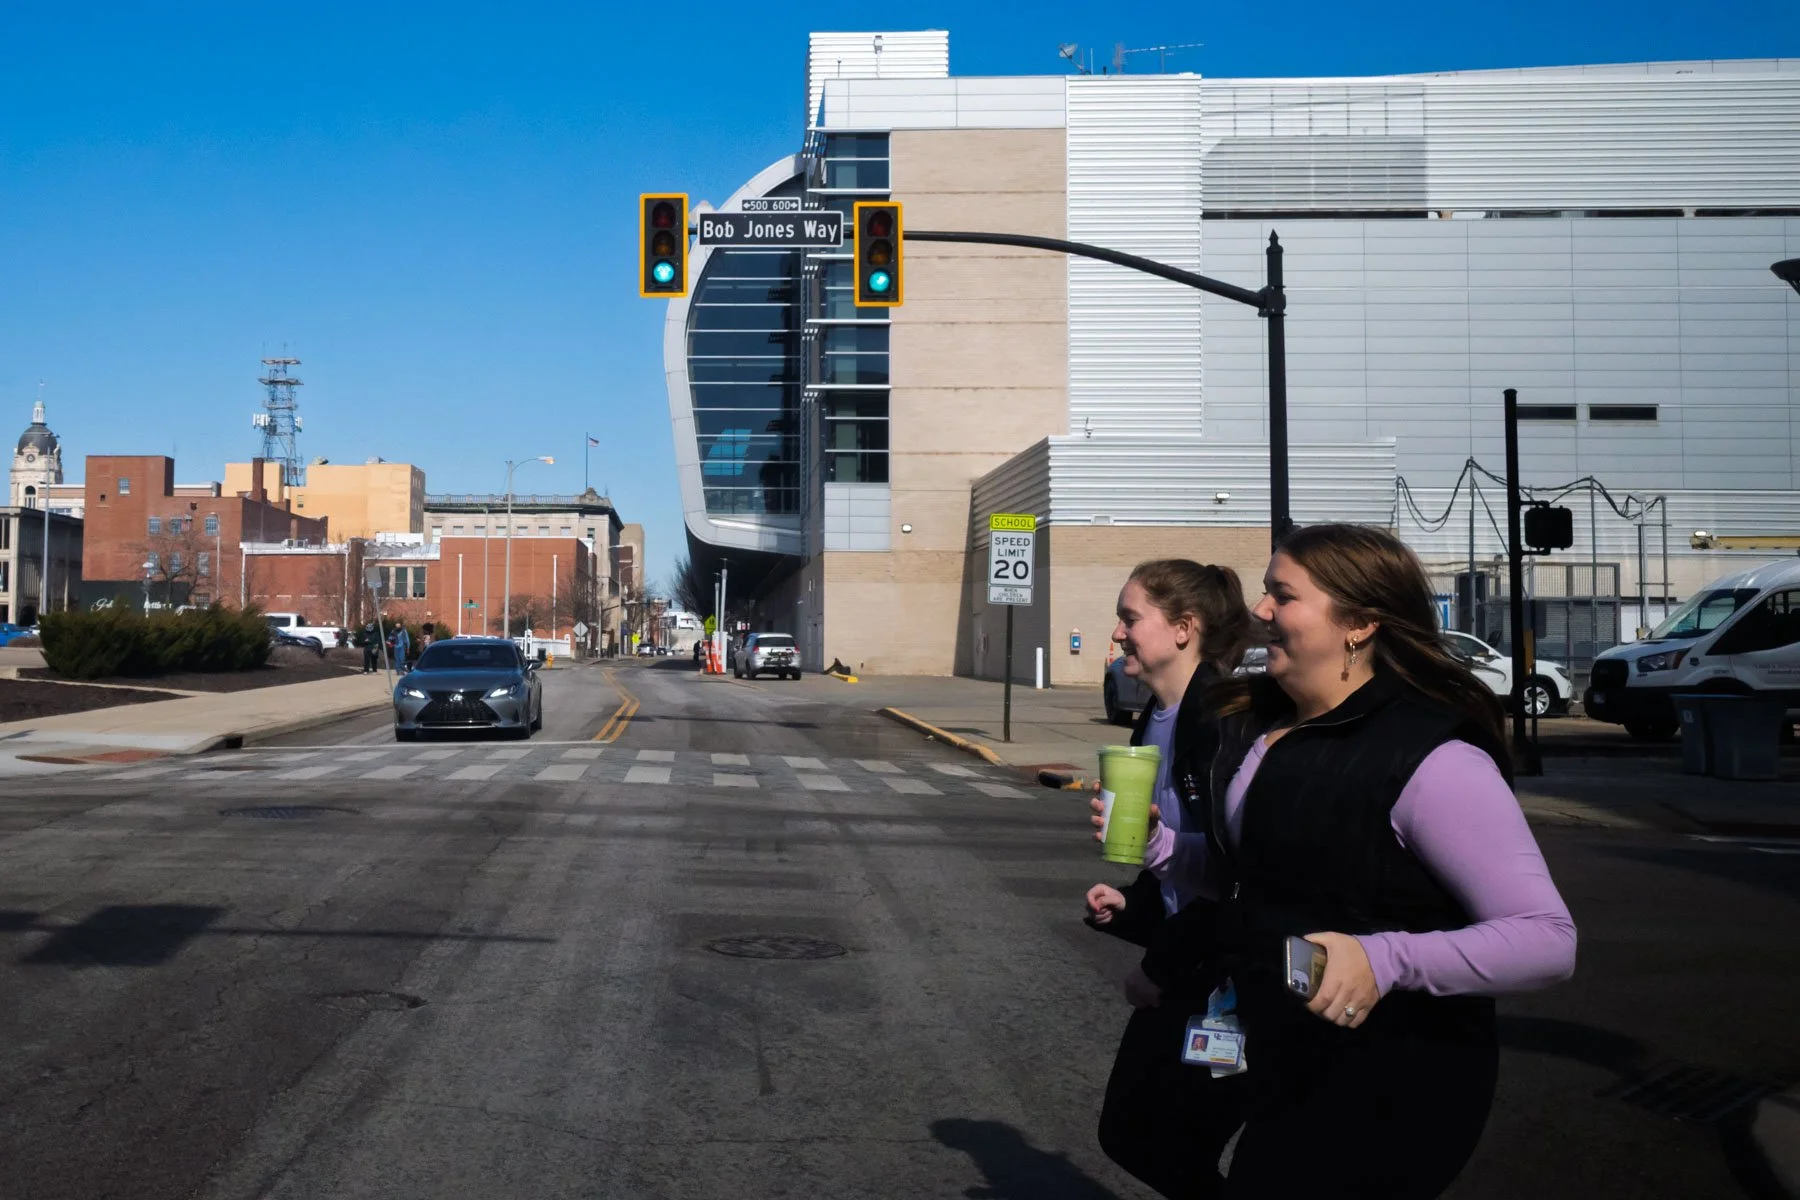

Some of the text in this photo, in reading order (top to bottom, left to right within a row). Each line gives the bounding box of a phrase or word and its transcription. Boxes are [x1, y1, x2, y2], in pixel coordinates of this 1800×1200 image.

[750, 200, 791, 210] 500 600
[703, 220, 838, 243] Bob Jones Way
[994, 517, 1033, 528] SCHOOL
[994, 536, 1031, 547] SPEED
[997, 548, 1027, 558] LIMIT
[994, 559, 1029, 580] 20
